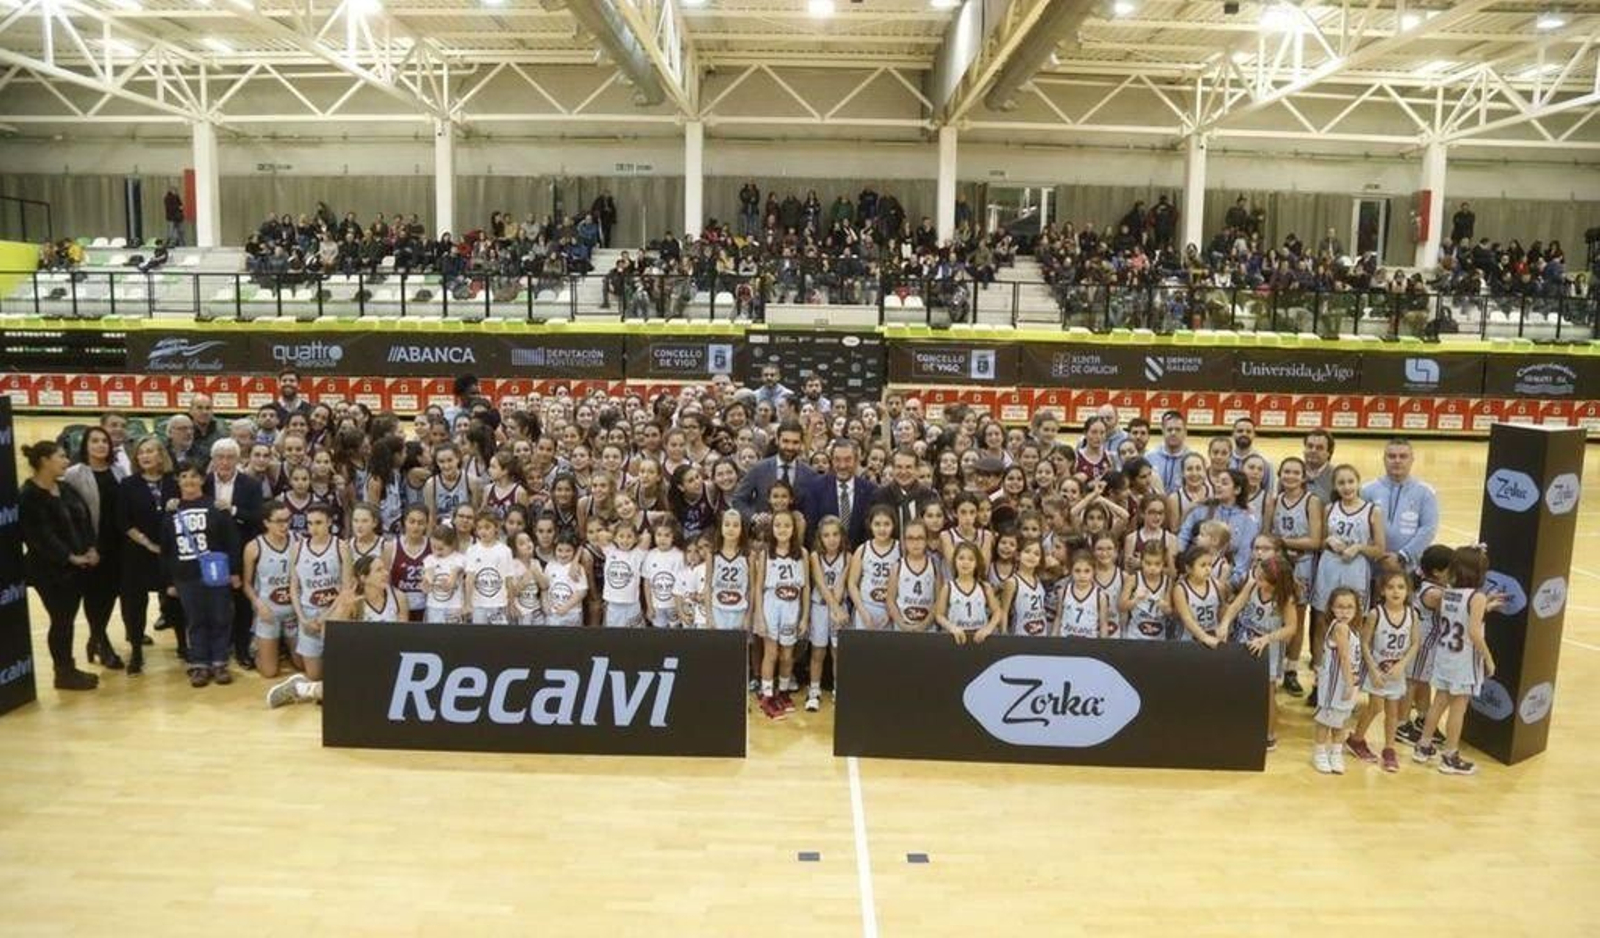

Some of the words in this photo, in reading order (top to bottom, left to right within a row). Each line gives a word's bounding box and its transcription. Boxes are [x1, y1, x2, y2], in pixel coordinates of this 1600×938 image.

[273, 340, 343, 364] quattro
[396, 347, 476, 363] ABANCA
[653, 349, 703, 359] CONCELLO
[916, 353, 965, 363] CONCELLO
[659, 359, 672, 367] DE
[674, 359, 698, 367] VIGO
[922, 363, 936, 372] DE
[938, 363, 961, 373] VIGO
[1282, 516, 1294, 531] 13
[1336, 521, 1354, 536] 37
[280, 560, 288, 574] 7
[312, 561, 328, 576] 21
[721, 566, 738, 582] 22
[778, 564, 793, 580] 21
[873, 562, 890, 577] 35
[912, 580, 922, 596] 4
[965, 601, 973, 619] 1
[1075, 607, 1084, 624] 7
[1196, 605, 1215, 622] 25
[1256, 606, 1265, 622] 9
[1386, 634, 1406, 650] 20
[386, 651, 680, 728] Recalvi
[1000, 674, 1105, 727] Zorka
